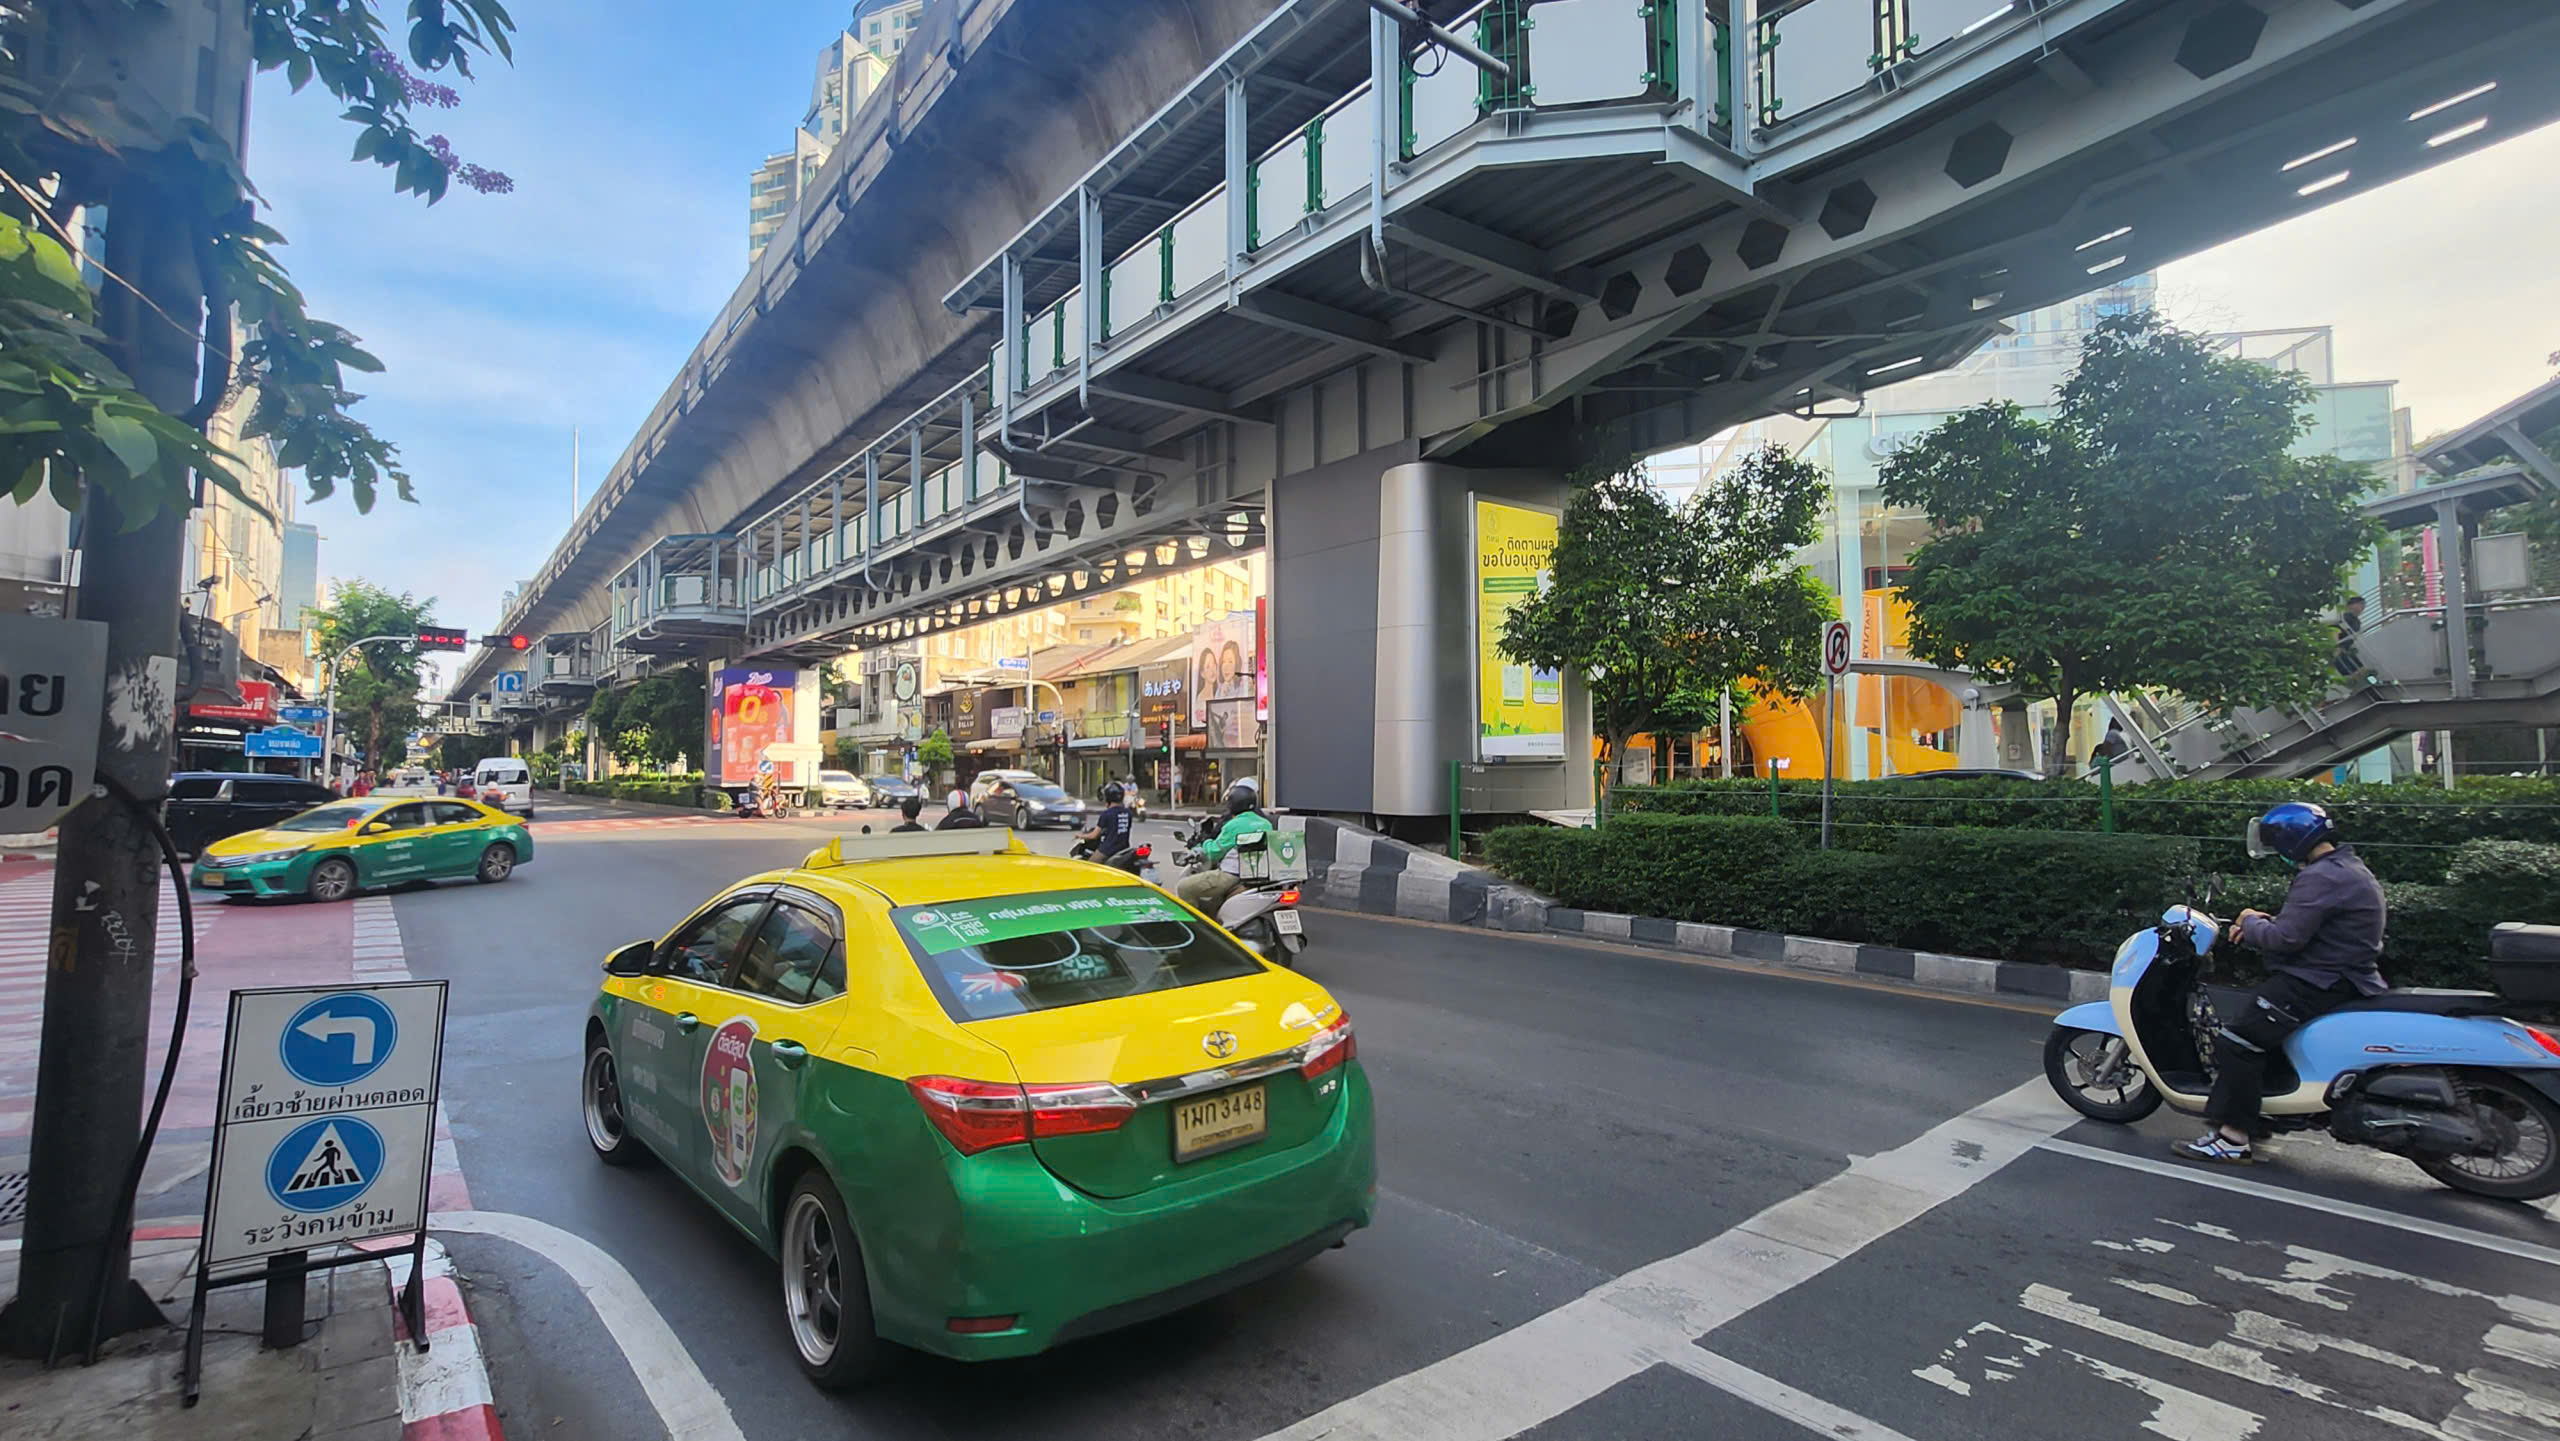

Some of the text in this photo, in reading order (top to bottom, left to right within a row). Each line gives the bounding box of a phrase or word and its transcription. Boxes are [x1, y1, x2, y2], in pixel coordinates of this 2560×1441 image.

[1507, 536, 1555, 552] ติดตามผล
[1143, 680, 1182, 697] あんまや
[233, 1084, 425, 1119] เลี้ยวซ้ายผ่านตลอด
[1181, 1091, 1263, 1131] 1มก 3448
[243, 1202, 394, 1245] ระวังคนข้าม
